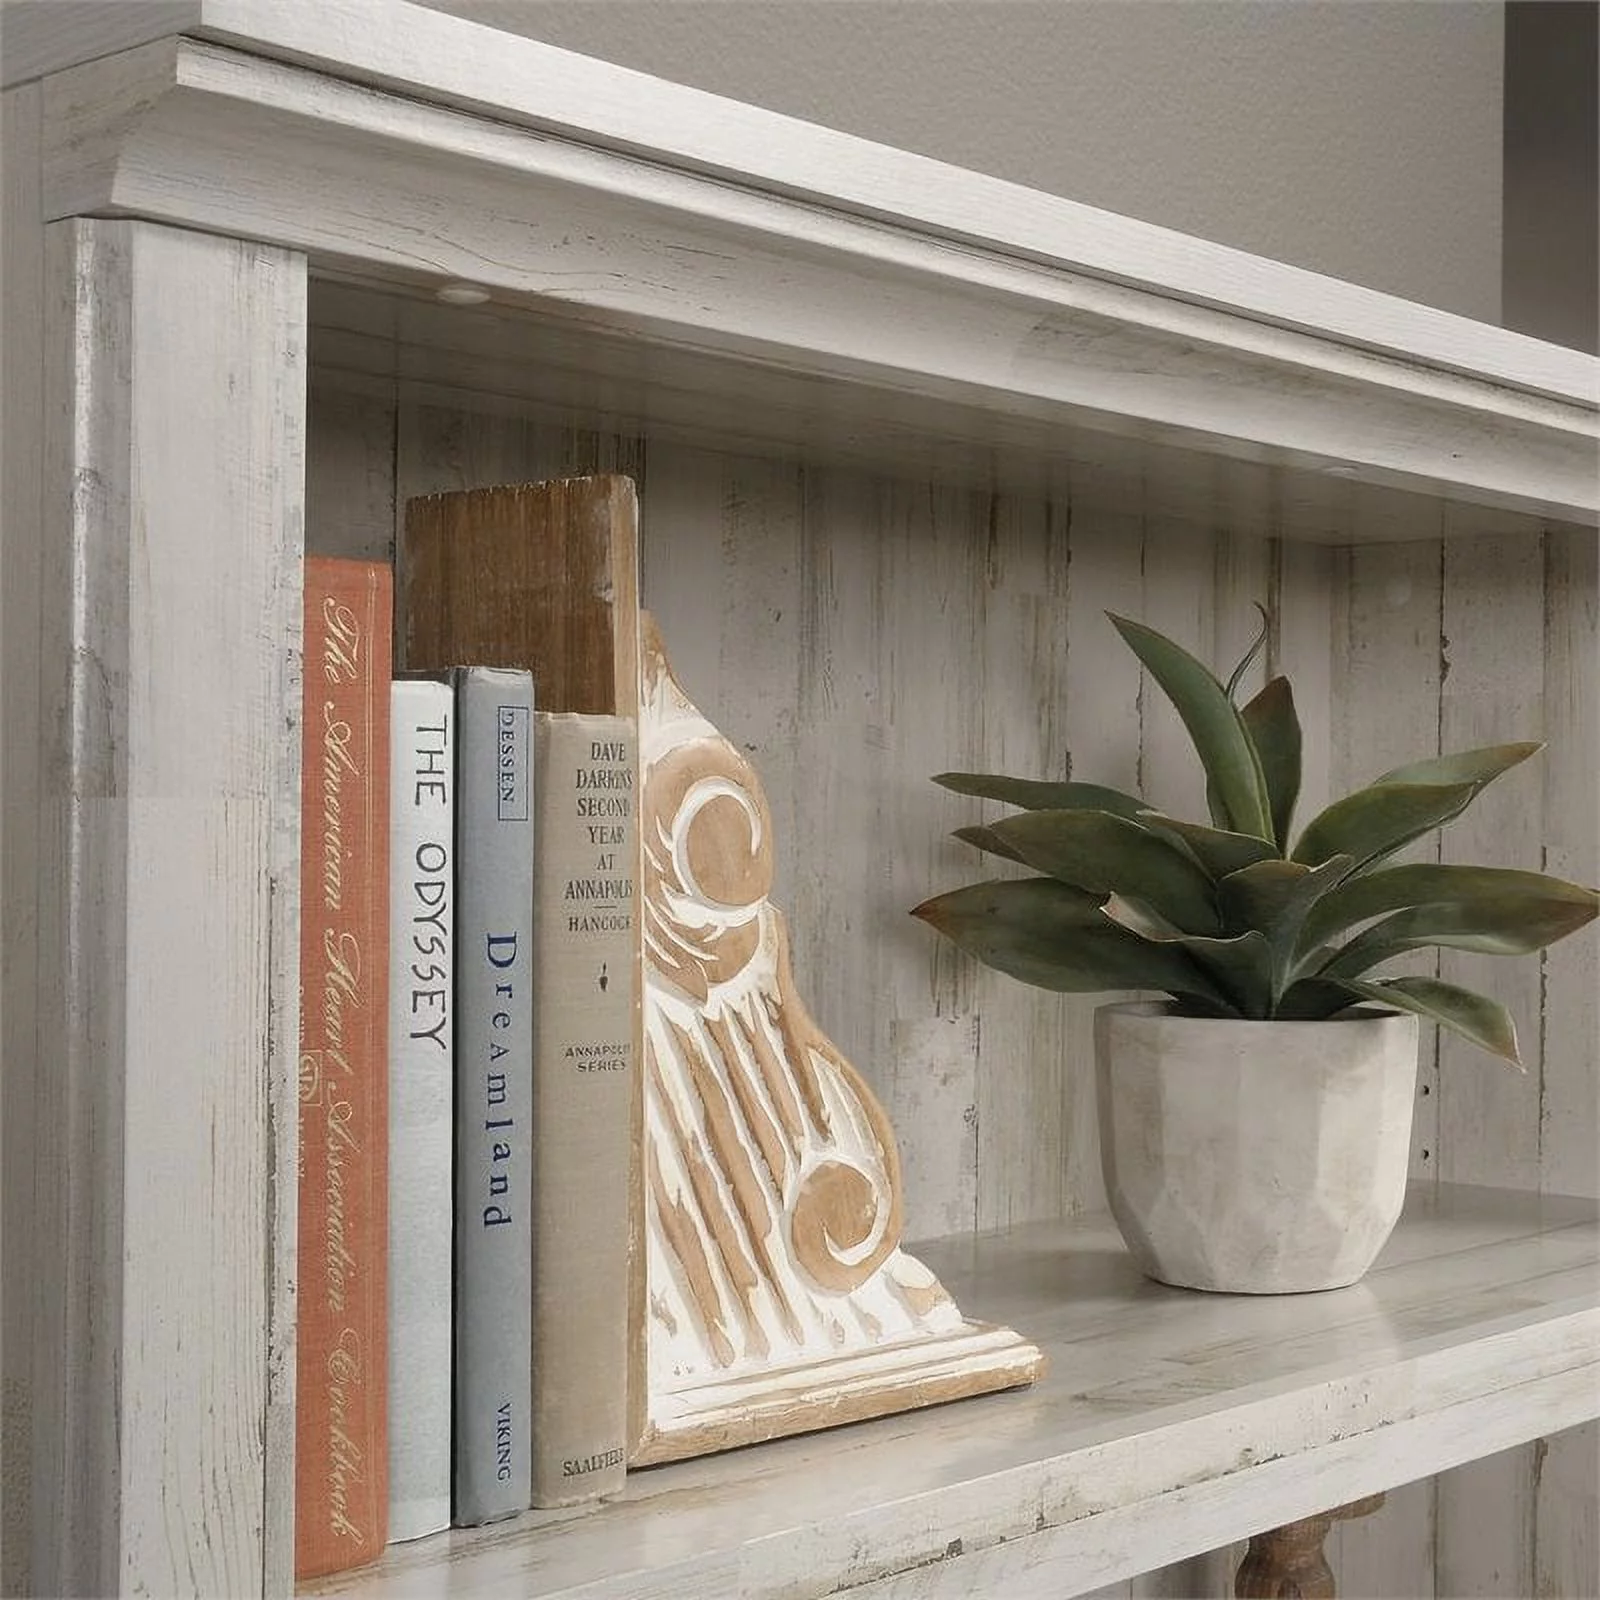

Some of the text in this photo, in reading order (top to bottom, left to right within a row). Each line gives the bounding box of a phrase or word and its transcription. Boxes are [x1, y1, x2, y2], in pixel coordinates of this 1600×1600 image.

[499, 711, 515, 804] DESSEN
[591, 742, 625, 762] DAVE
[588, 825, 625, 844] YEAR
[596, 853, 616, 870] AT
[410, 714, 448, 1049] THE ODYSSEY
[323, 597, 364, 1545] The American Heart Association Cookbook
[497, 1402, 512, 1482] VIKING
